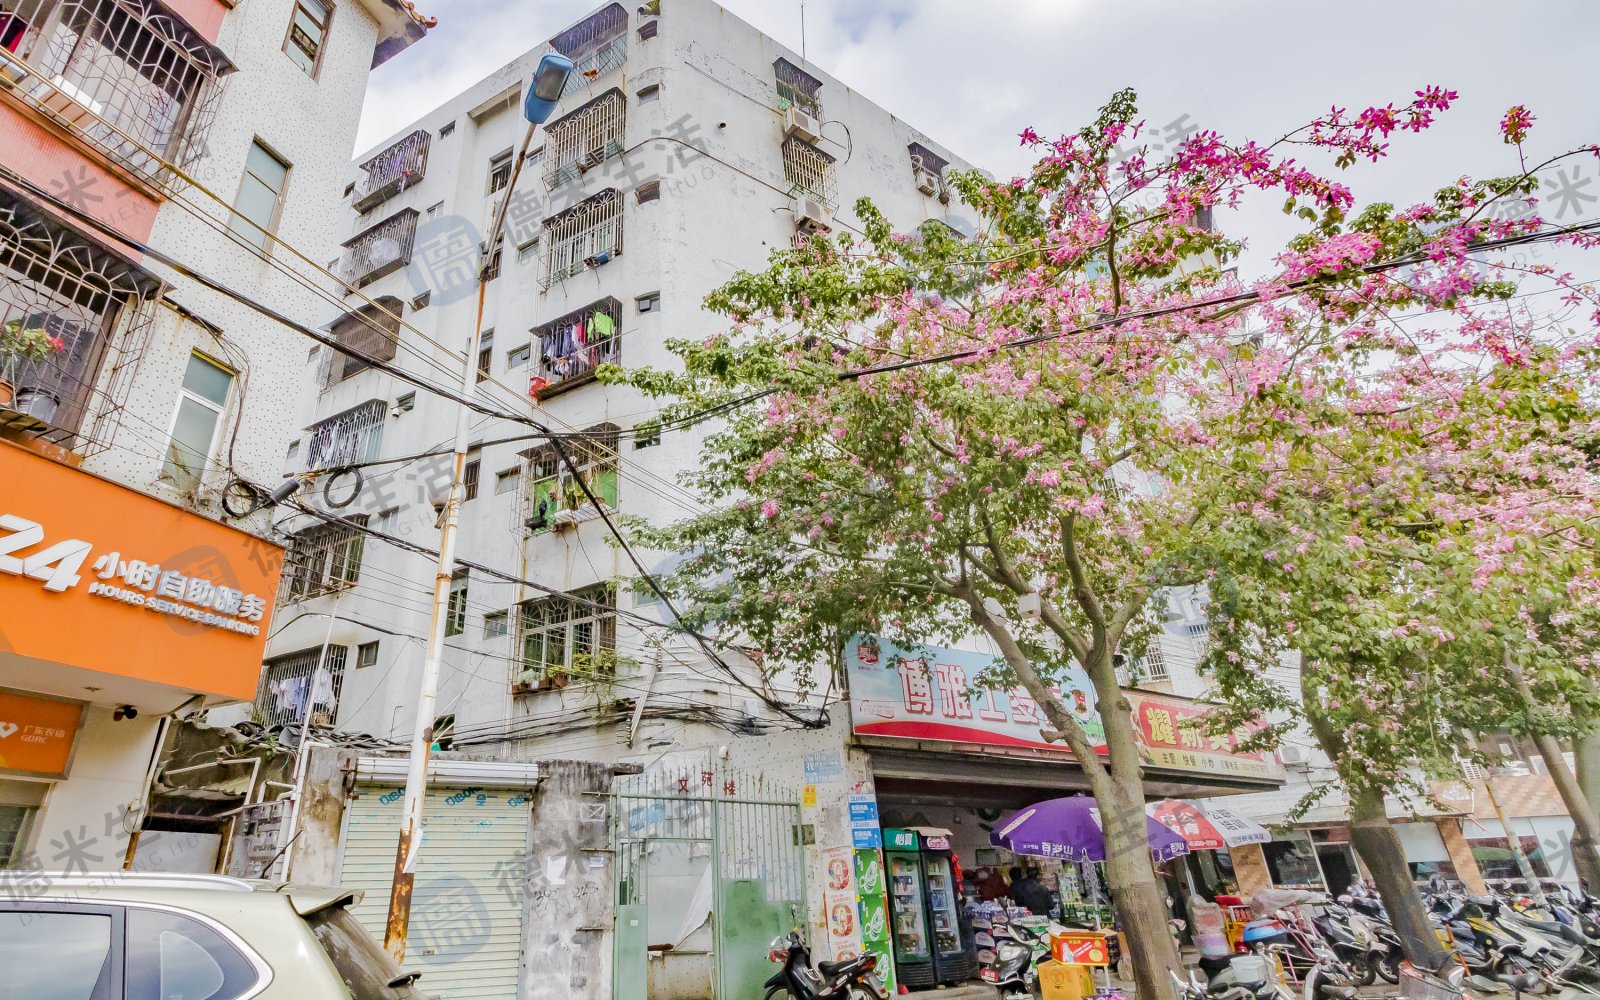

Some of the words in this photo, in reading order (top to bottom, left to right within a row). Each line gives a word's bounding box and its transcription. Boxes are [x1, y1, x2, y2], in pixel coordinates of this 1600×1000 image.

[0, 513, 93, 592] 24
[88, 581, 145, 605] HOURS
[145, 597, 205, 623] SERVICE
[202, 612, 260, 636] BANKING
[92, 551, 266, 622] 小时自助服务
[898, 657, 1063, 726] 博雅士多
[21, 734, 48, 744] GDRC
[1146, 706, 1256, 754] 耀新
[1042, 841, 1074, 856] 百岁山
